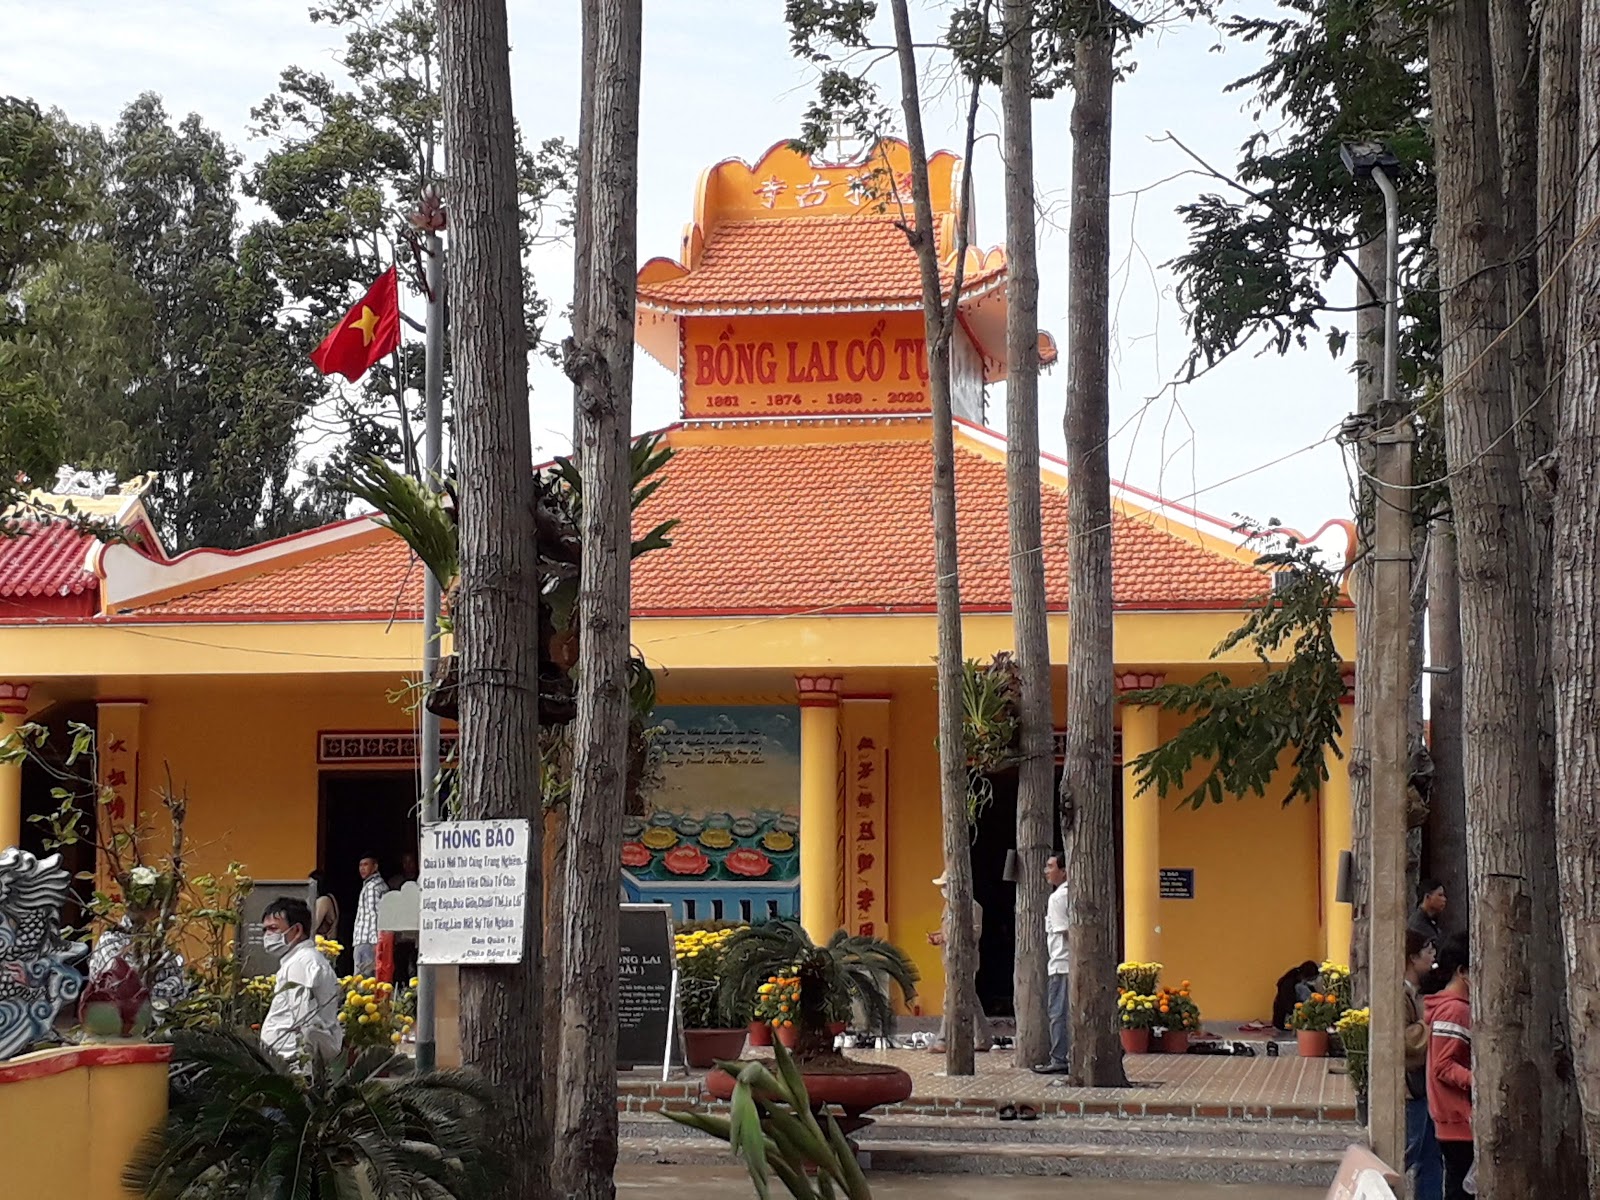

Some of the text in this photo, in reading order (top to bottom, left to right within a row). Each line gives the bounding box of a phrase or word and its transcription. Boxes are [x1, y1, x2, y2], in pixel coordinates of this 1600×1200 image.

[694, 323, 777, 386] BỒNG
[786, 340, 838, 383] LAI
[846, 319, 886, 382] CỔ
[766, 394, 802, 406] 1874
[888, 392, 924, 404] 2020
[434, 823, 514, 850] THÔNG BÁO
